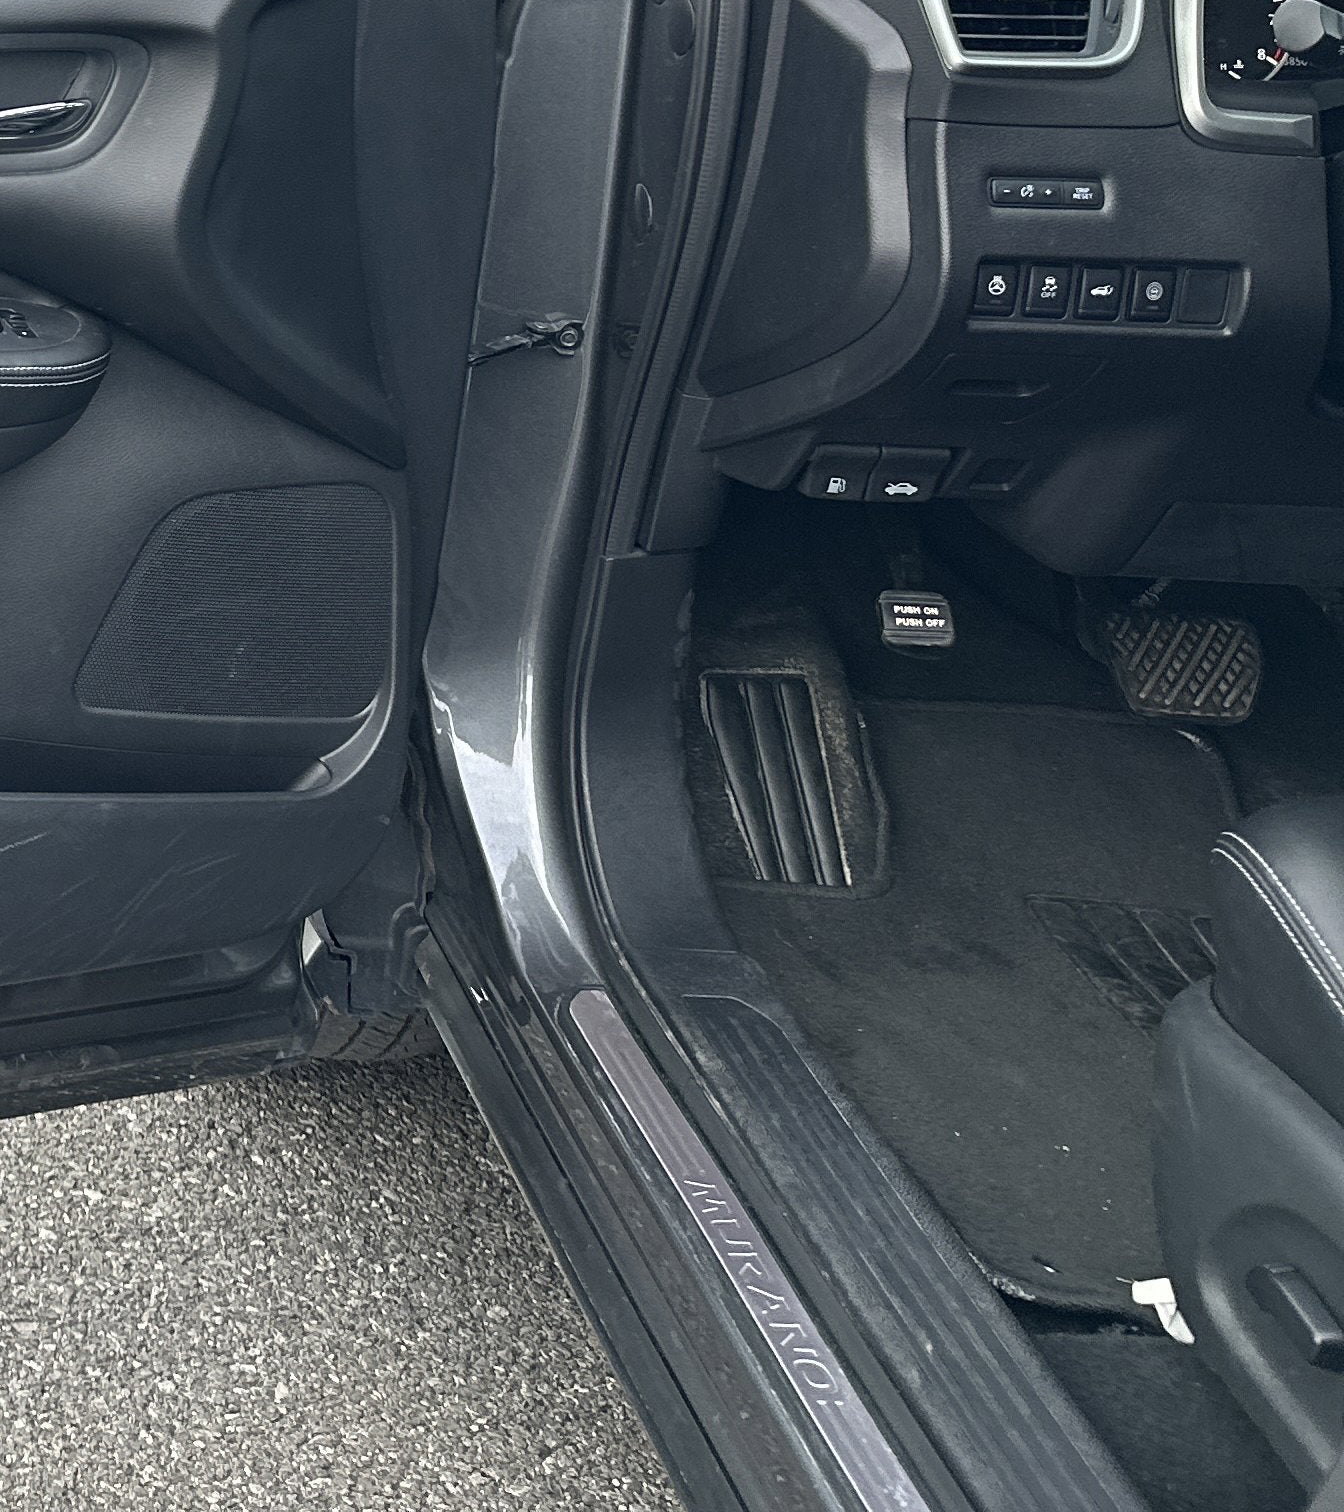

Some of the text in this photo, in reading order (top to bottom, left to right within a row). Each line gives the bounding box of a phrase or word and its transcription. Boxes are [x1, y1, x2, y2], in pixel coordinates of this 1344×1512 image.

[1257, 48, 1266, 61] 8
[893, 605, 939, 616] PUSH ON
[895, 617, 946, 628] PUSH OFF
[683, 1179, 840, 1394] MURANO
